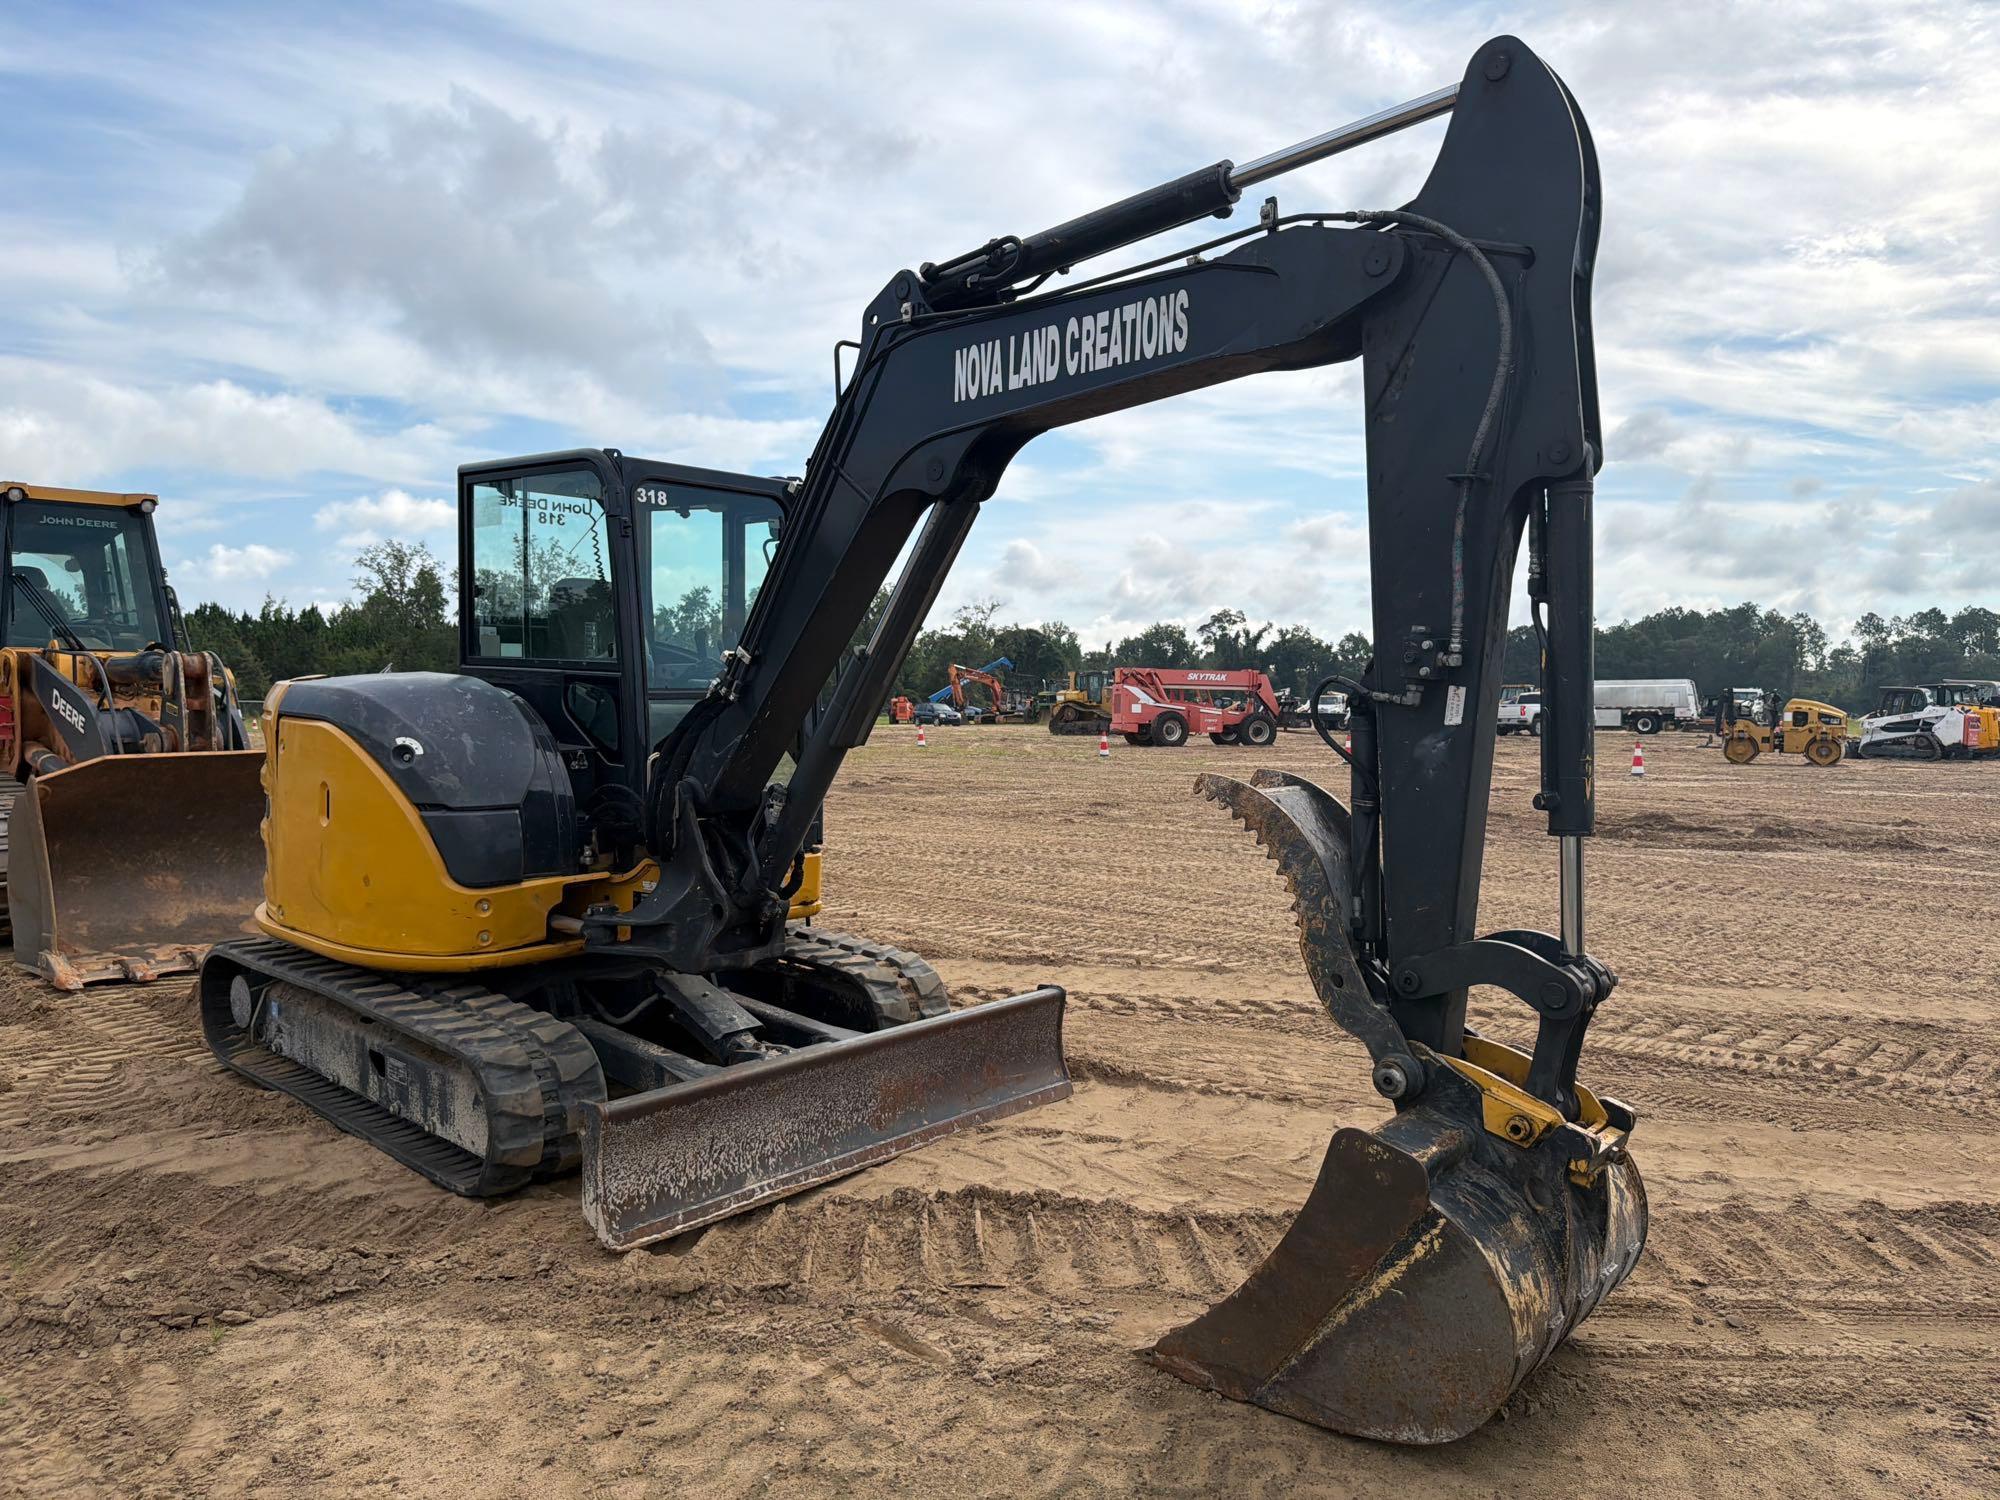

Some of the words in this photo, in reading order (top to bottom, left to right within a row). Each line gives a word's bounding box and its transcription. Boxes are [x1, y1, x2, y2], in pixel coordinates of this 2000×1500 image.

[954, 339, 1003, 403] NOVA
[1008, 324, 1060, 390] LAND
[1065, 289, 1189, 376] CREATIONS
[636, 487, 668, 506] 318
[40, 514, 74, 526] JOHN
[76, 517, 118, 529] DEERE
[1187, 672, 1227, 681] SKYTRAK
[52, 688, 86, 734] DEERE
